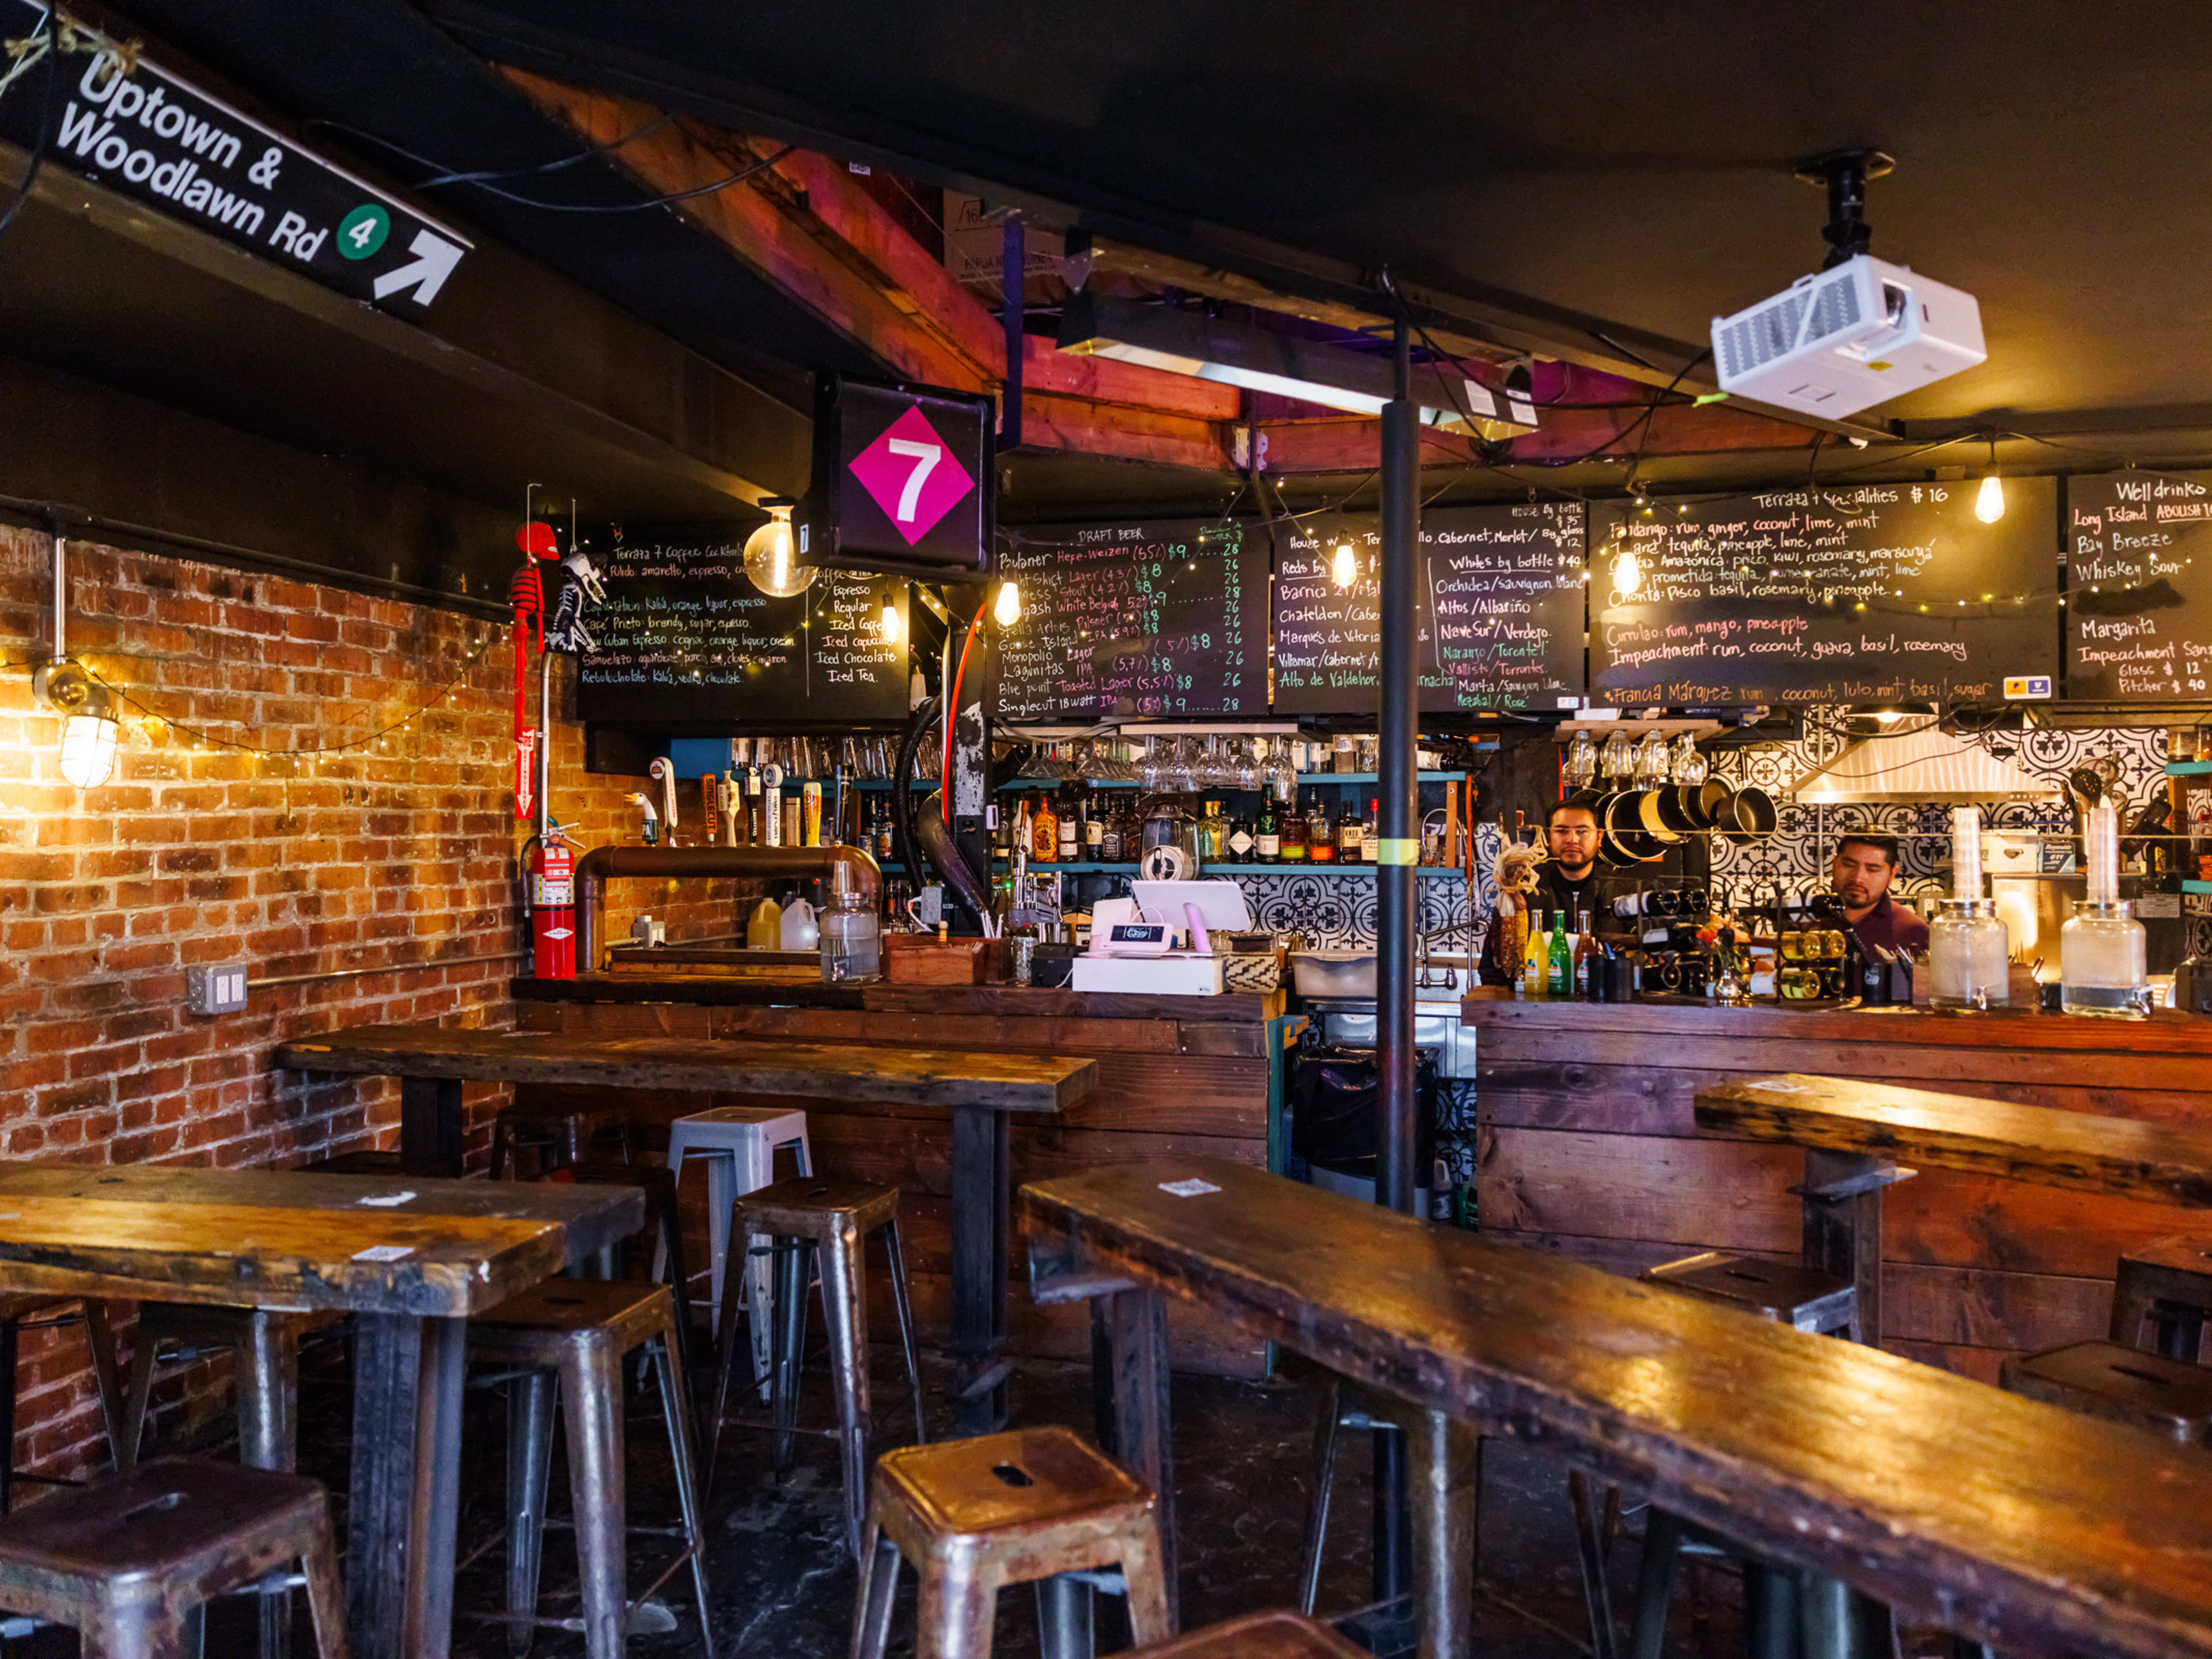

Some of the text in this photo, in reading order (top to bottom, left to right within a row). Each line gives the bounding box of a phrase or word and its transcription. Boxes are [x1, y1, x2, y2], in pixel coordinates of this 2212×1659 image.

[79, 52, 283, 190] Uptown &
[57, 102, 378, 262] Woodlawn Rd 4
[889, 437, 941, 522] 7
[2115, 478, 2207, 501] Well drinks
[1559, 503, 1584, 514] bottle
[1752, 493, 1809, 509] Terraza
[1567, 516, 1581, 526] 35
[1753, 511, 1805, 536] coconut,
[1806, 514, 1842, 533] lime,
[1846, 510, 1880, 528] mint
[2074, 502, 2202, 536] Long Island ABOLISH
[801, 525, 809, 552] 7
[1078, 528, 1145, 543] DRAFT BEER
[1560, 525, 1584, 540] glass
[1779, 532, 1812, 550] lime,
[1816, 531, 1849, 547] mint
[1290, 536, 1320, 550] House
[1567, 537, 1582, 548] 12
[1806, 551, 1870, 564] rosemary,
[1870, 538, 1937, 566] maracuyá
[2077, 532, 2173, 563] Bay Breeze
[613, 547, 650, 560] Terraza
[666, 546, 702, 563] Coffee
[999, 546, 1129, 570] Paulaner Hefe-Weizen
[1449, 553, 1554, 575] Whites by bottle
[641, 563, 685, 579] amaretto,
[688, 566, 732, 579] espresso,
[1032, 559, 1239, 592] Shift Lager 26
[1282, 559, 1308, 576] Reds
[1312, 560, 1327, 577] by
[1858, 562, 1891, 579] mint,
[1895, 562, 1921, 576] lime
[2075, 557, 2184, 587] Whiskey Sour
[1059, 572, 1239, 597] Stout 26
[1556, 574, 1585, 590] blanc
[833, 585, 870, 600] Espresso
[1056, 596, 1088, 613] White
[1224, 586, 1241, 599] 28
[1280, 585, 1327, 601] Barrica
[1666, 585, 1702, 601] Pisco
[1709, 581, 1751, 599] basil,
[1752, 583, 1822, 604] rosemary,
[672, 601, 703, 618] orange
[834, 598, 873, 619] Regular
[1225, 600, 1239, 613] 26
[1279, 603, 1342, 623] Chateldon
[1440, 599, 1469, 615] Altos
[584, 616, 717, 633] Café Prieto: sugar,
[830, 616, 855, 631] Iced
[1076, 612, 1113, 630] Pilsner
[1223, 615, 1241, 628] 26
[1665, 616, 1809, 639] rum, mango, pineapple
[2081, 615, 2156, 641] Margarita
[604, 636, 630, 647] Cuban
[709, 637, 738, 652] orange
[741, 634, 767, 649] liquor,
[821, 634, 848, 647] Iced
[1040, 630, 1079, 649] Island
[1225, 631, 1243, 645] 26
[1279, 628, 1381, 649] Marqués de Vitoria
[813, 648, 897, 664] Iced Chocolate
[1002, 646, 1244, 666] Monopolio Lager 26
[1608, 633, 1900, 669] Impeachment: rum, coconut, guava, basil,
[2077, 640, 2175, 667] Impeachment
[826, 668, 854, 683] Iced
[1003, 662, 1241, 687] Lagunitas IPA 26
[2118, 661, 2201, 677] Glass 12
[999, 675, 1134, 698] Blue point Toasted Lager
[1280, 671, 1324, 687] Alto de
[1458, 679, 1495, 692] Marta
[2118, 676, 2206, 694] Pitcher 40
[1613, 683, 1662, 703] Francia
[1740, 687, 1764, 701] rum
[1781, 683, 1838, 702] coconut,
[1843, 680, 1876, 698] lulo,
[1876, 676, 1906, 703] mint,
[1910, 677, 1953, 702] basil,
[1953, 682, 1993, 701] sugar
[998, 695, 1119, 717] Singlecut IPA
[1504, 695, 1529, 708] Rosé
[706, 778, 716, 831] SINGLECUT
